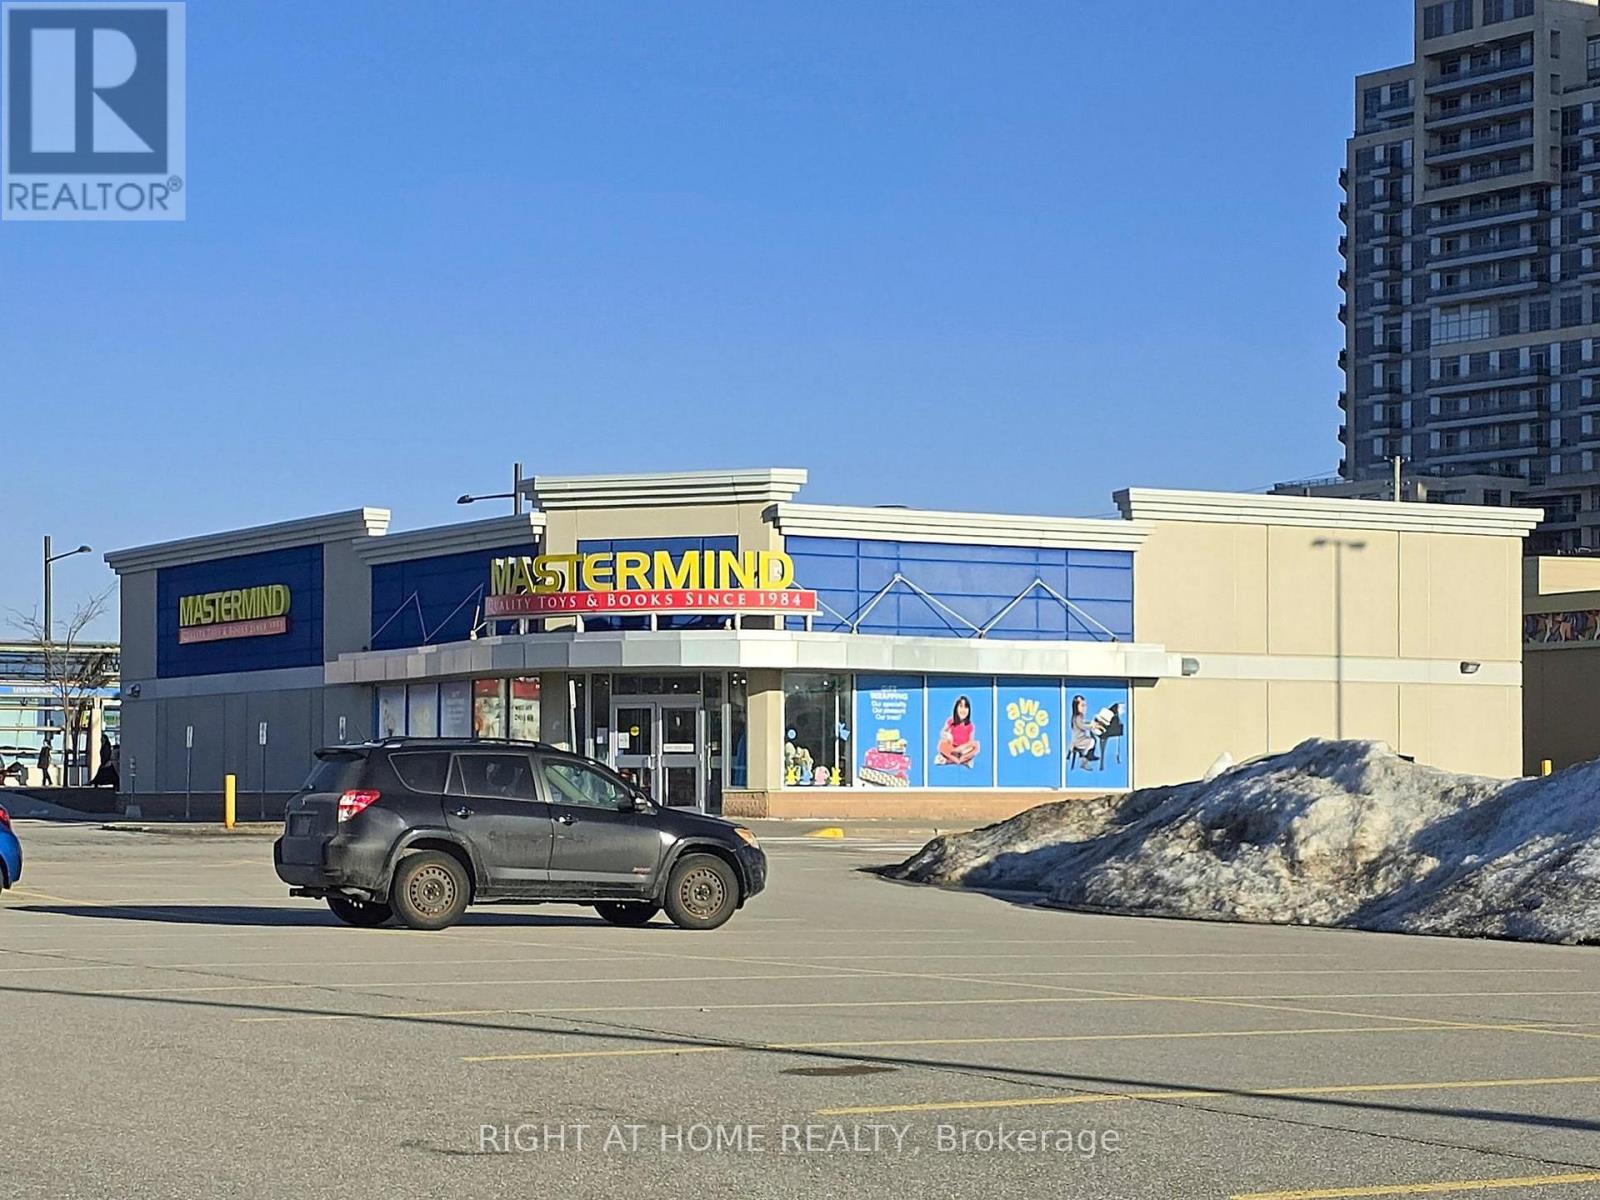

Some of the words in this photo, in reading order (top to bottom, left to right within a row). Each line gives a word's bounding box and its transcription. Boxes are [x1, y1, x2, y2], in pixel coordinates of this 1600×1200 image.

[491, 550, 794, 595] MASTERMIND
[179, 584, 291, 627] MASTERMIND
[488, 596, 531, 614] QUALITY
[538, 596, 577, 609] TOYS
[586, 594, 598, 607] &
[607, 593, 673, 607] BOOKS
[685, 591, 746, 606] SINCE
[760, 592, 801, 606] 1984
